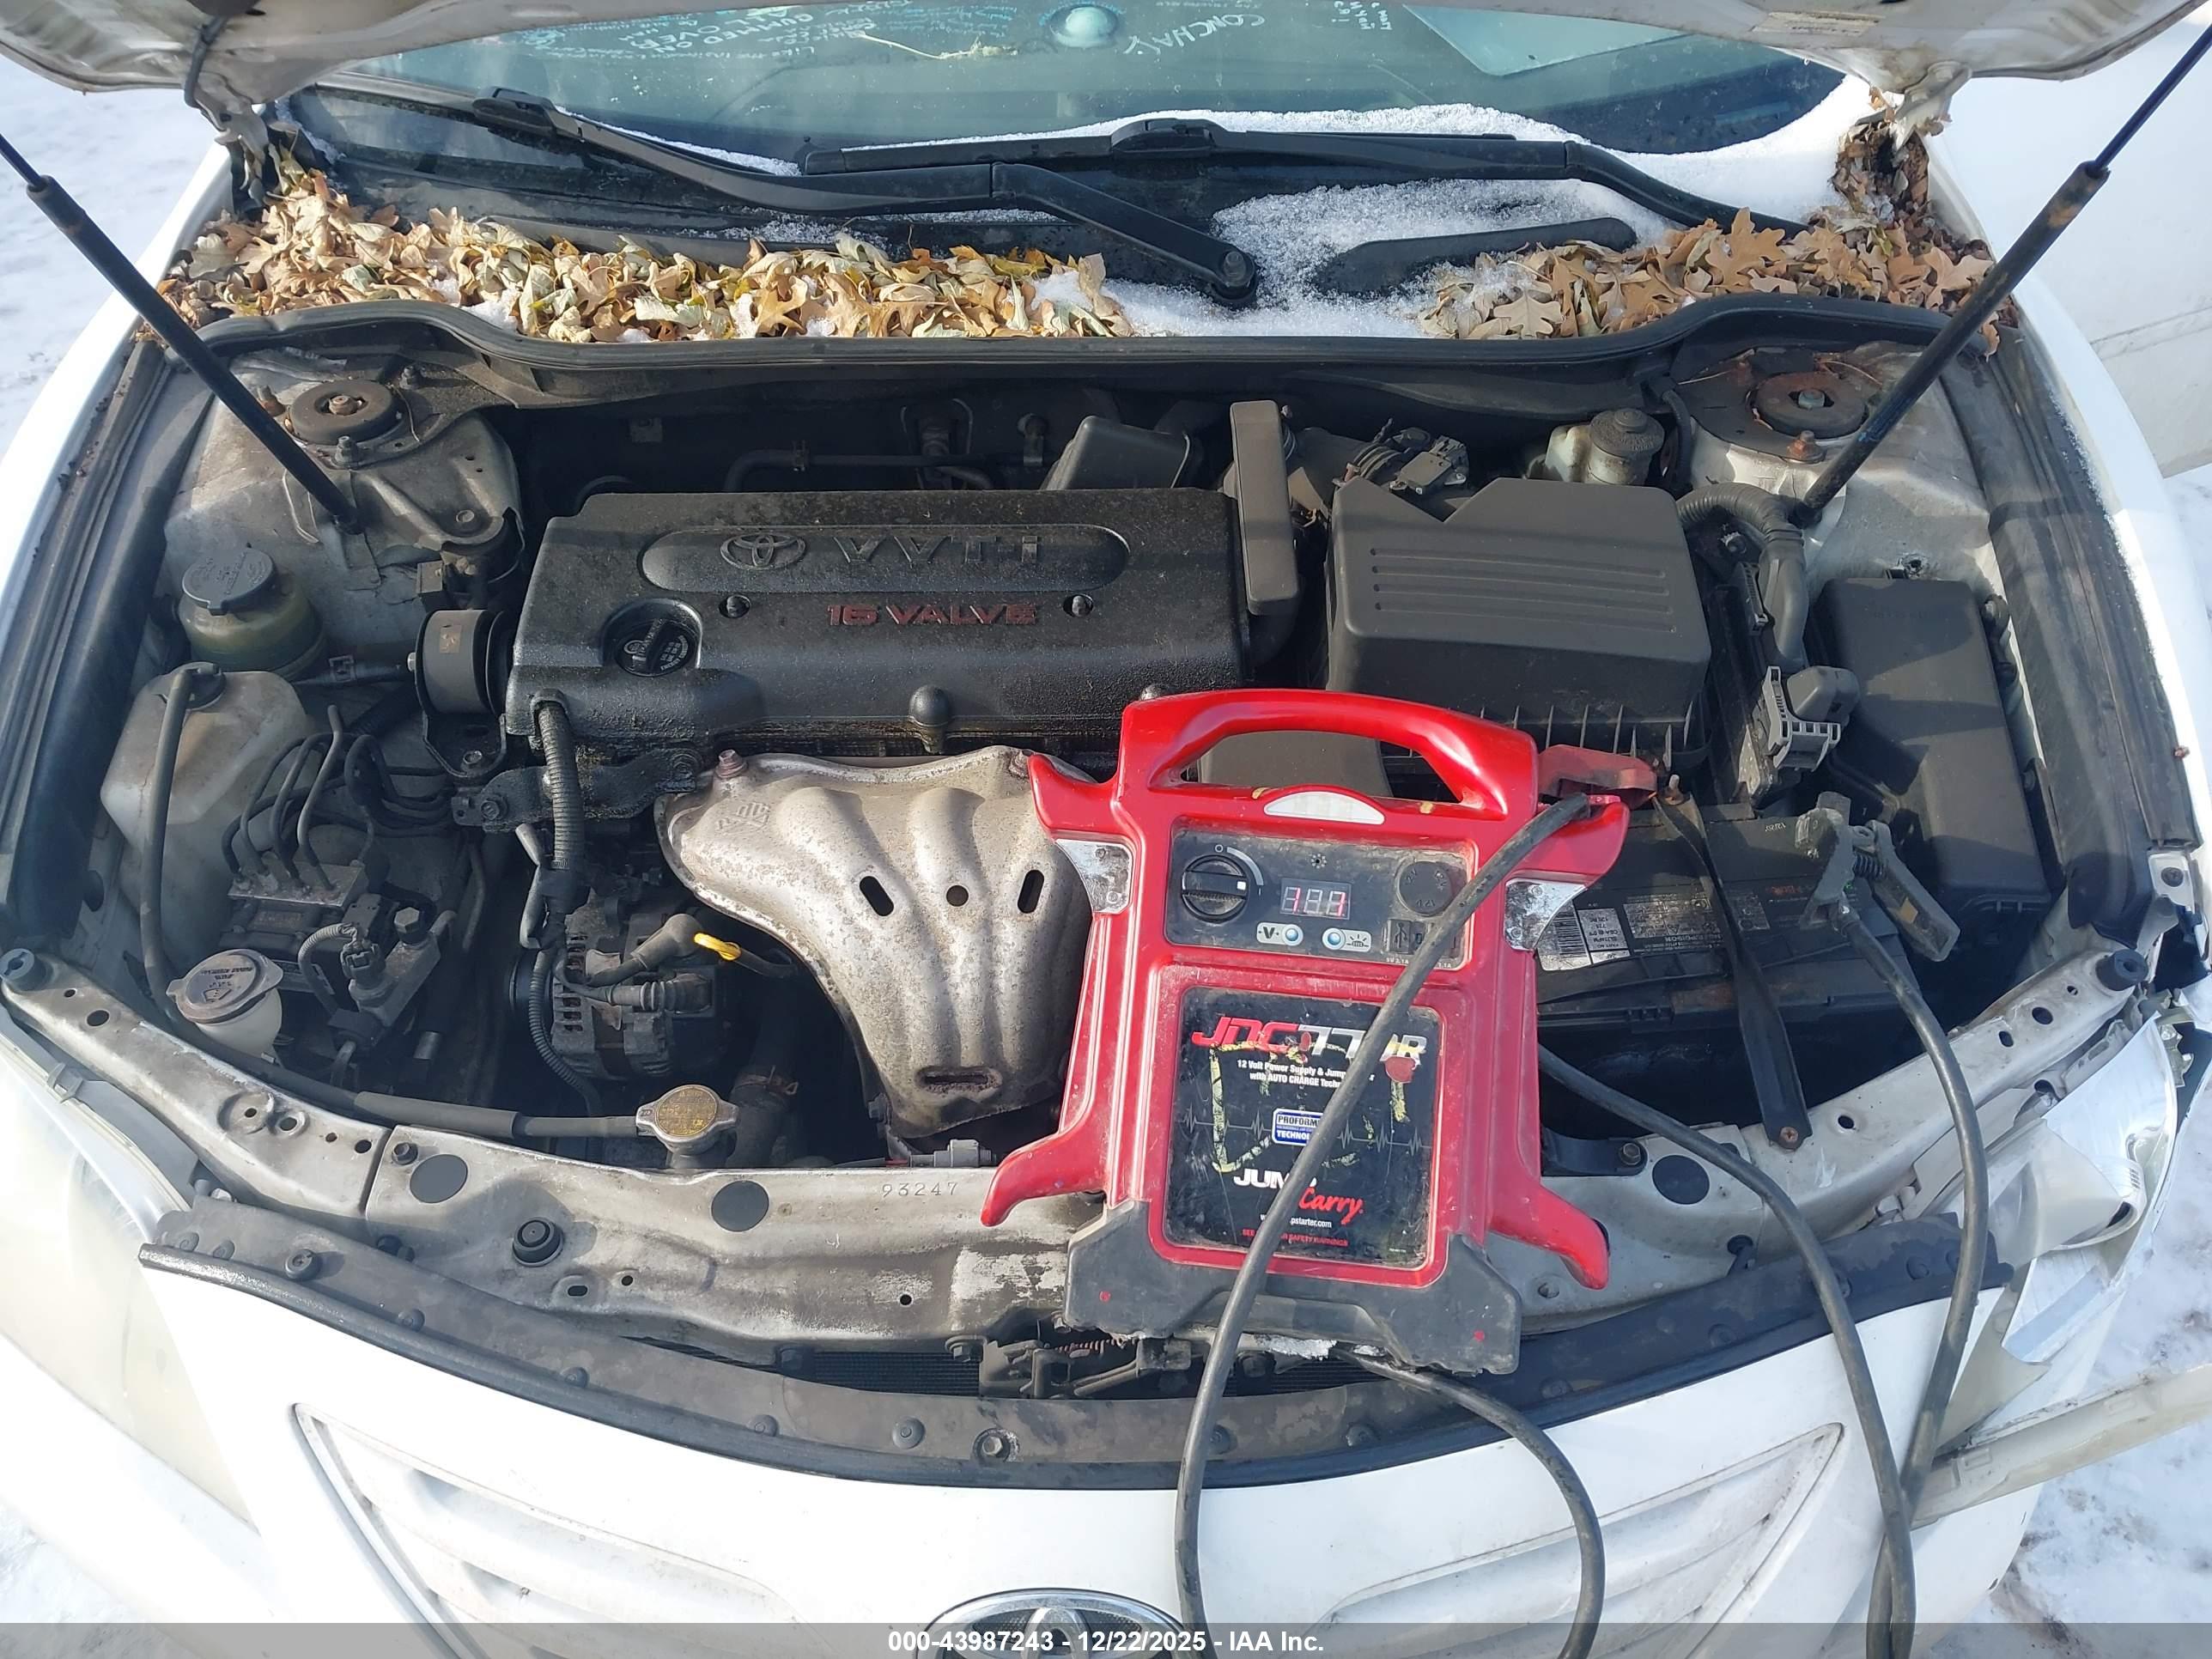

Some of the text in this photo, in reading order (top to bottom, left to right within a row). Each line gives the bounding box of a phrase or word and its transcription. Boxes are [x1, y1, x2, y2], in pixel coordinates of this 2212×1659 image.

[826, 603, 1039, 626] 16 VALVE
[1237, 1059, 1248, 1069] 12
[1248, 1060, 1263, 1070] Volt
[1264, 1062, 1289, 1073] Power
[1290, 1065, 1316, 1076] Supply
[1267, 1074, 1287, 1084] AUTO
[1289, 1076, 1319, 1086] CHARGE
[1298, 1188, 1363, 1225] Carry
